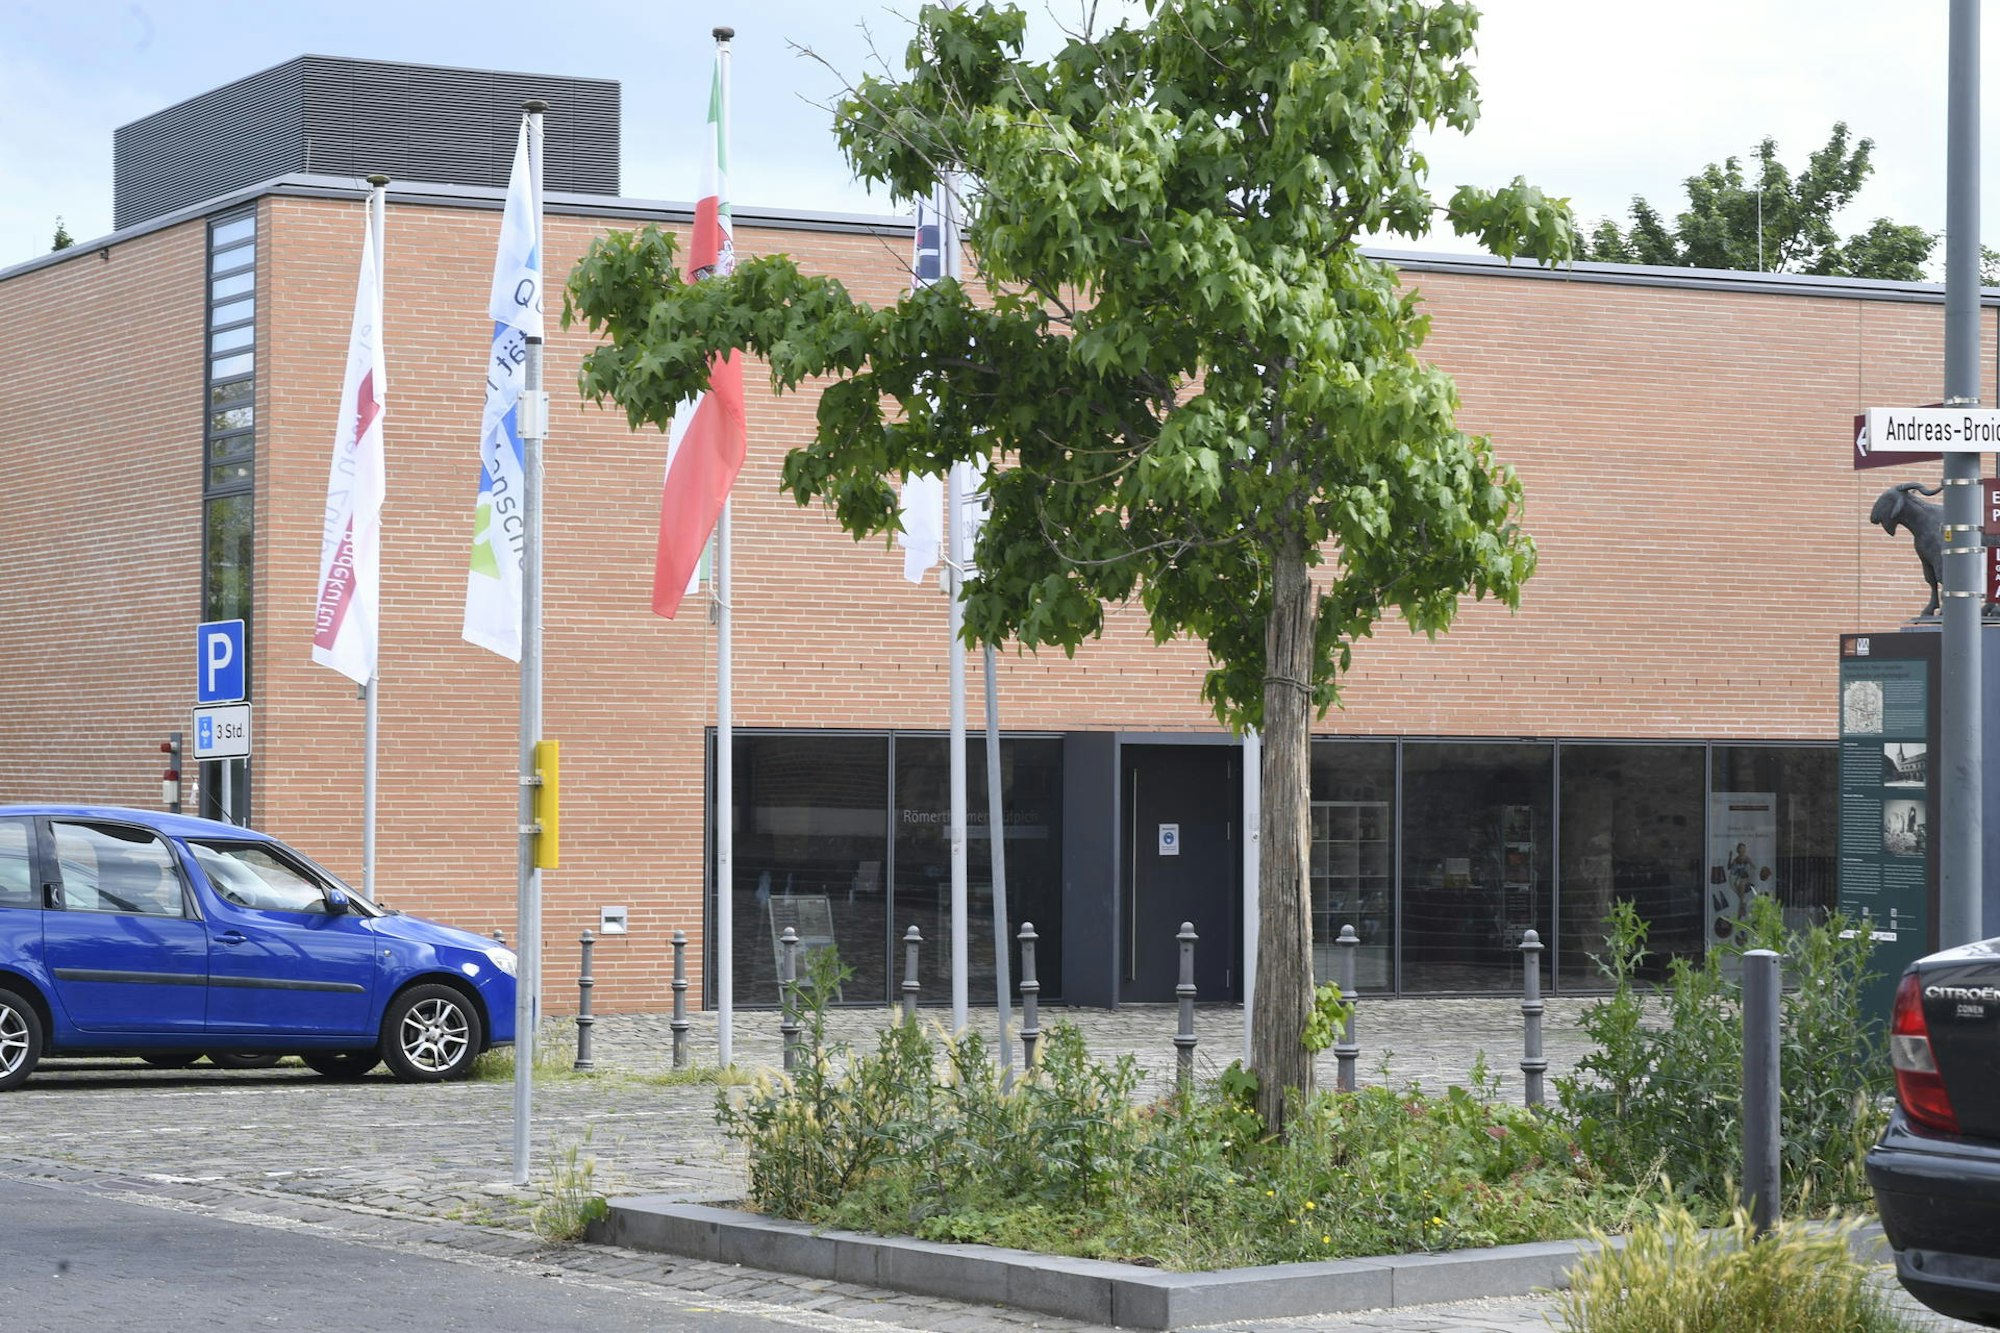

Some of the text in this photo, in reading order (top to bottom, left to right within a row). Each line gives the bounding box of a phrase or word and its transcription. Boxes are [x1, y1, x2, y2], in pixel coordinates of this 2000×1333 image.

[207, 632, 233, 692] P
[216, 722, 246, 739] 3 Std.
